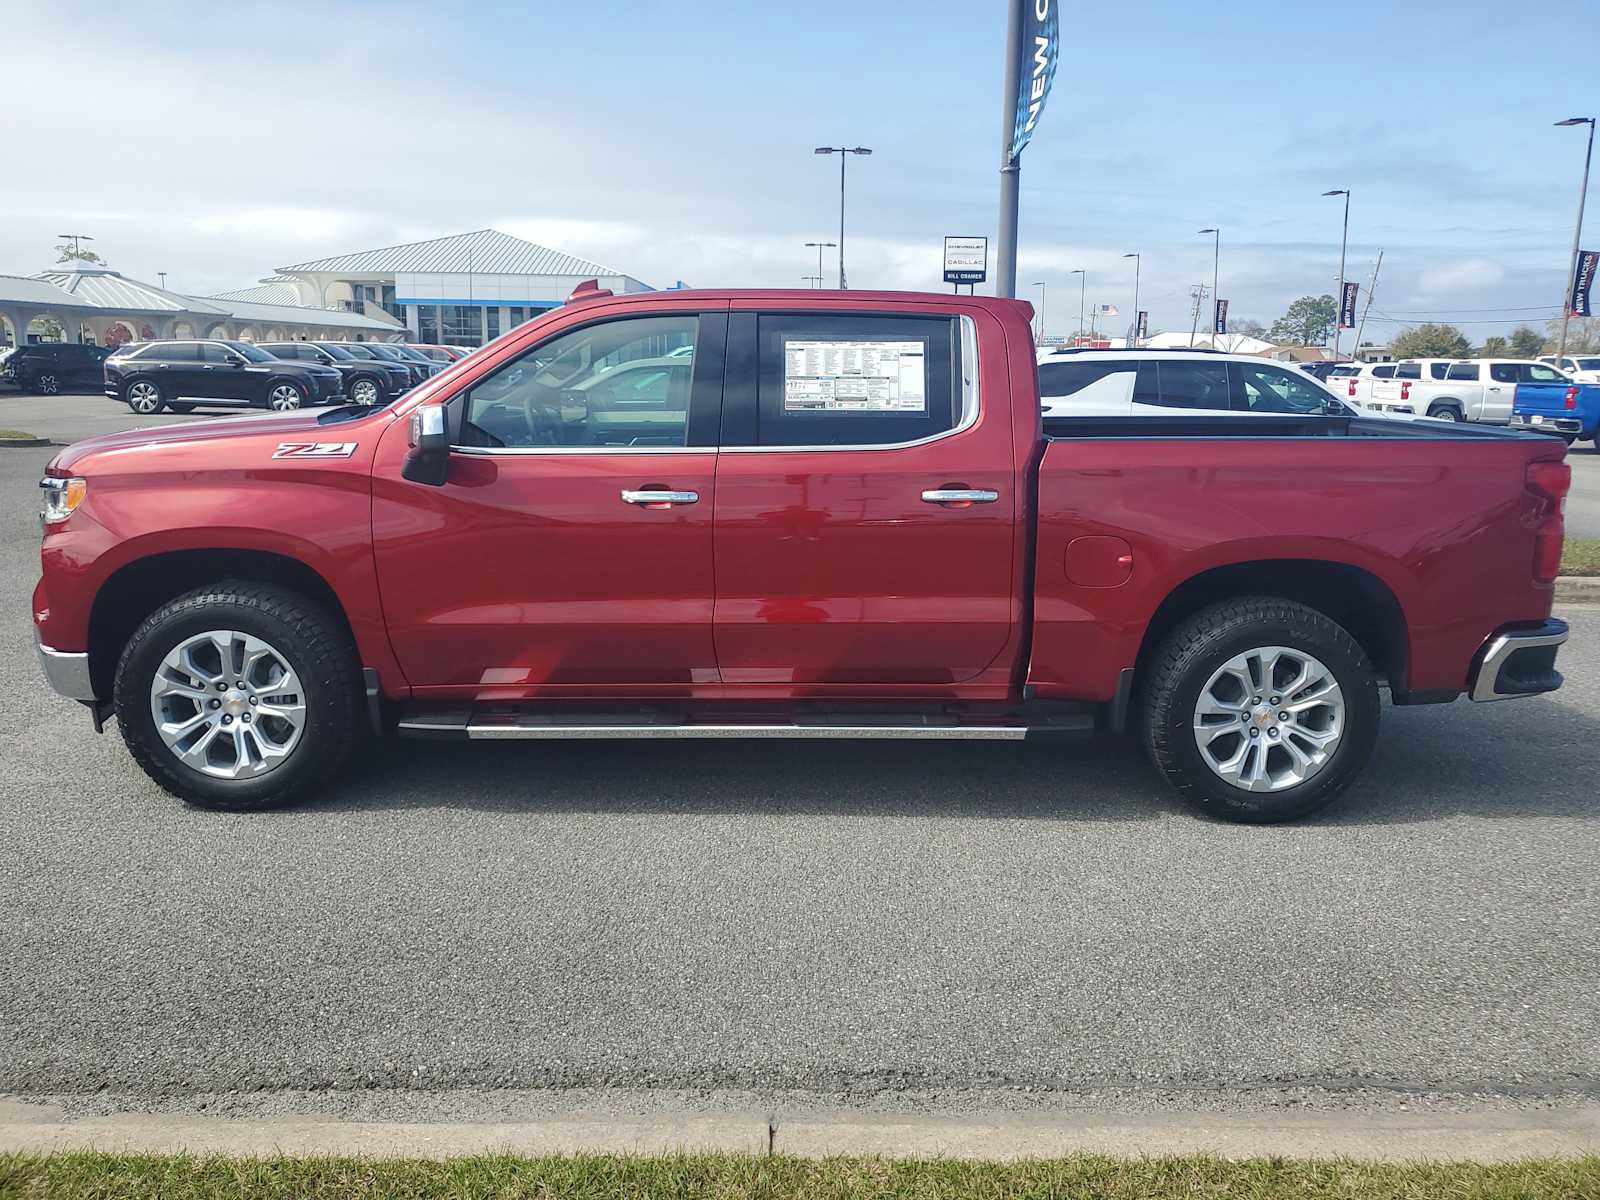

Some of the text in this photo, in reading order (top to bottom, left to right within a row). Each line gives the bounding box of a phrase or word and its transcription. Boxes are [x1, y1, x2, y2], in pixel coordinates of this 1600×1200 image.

[1024, 36, 1049, 133] NEW
[1345, 285, 1354, 310] TRUCKS
[1575, 254, 1593, 313] NEW TRUCKS
[272, 442, 359, 460] Z71
